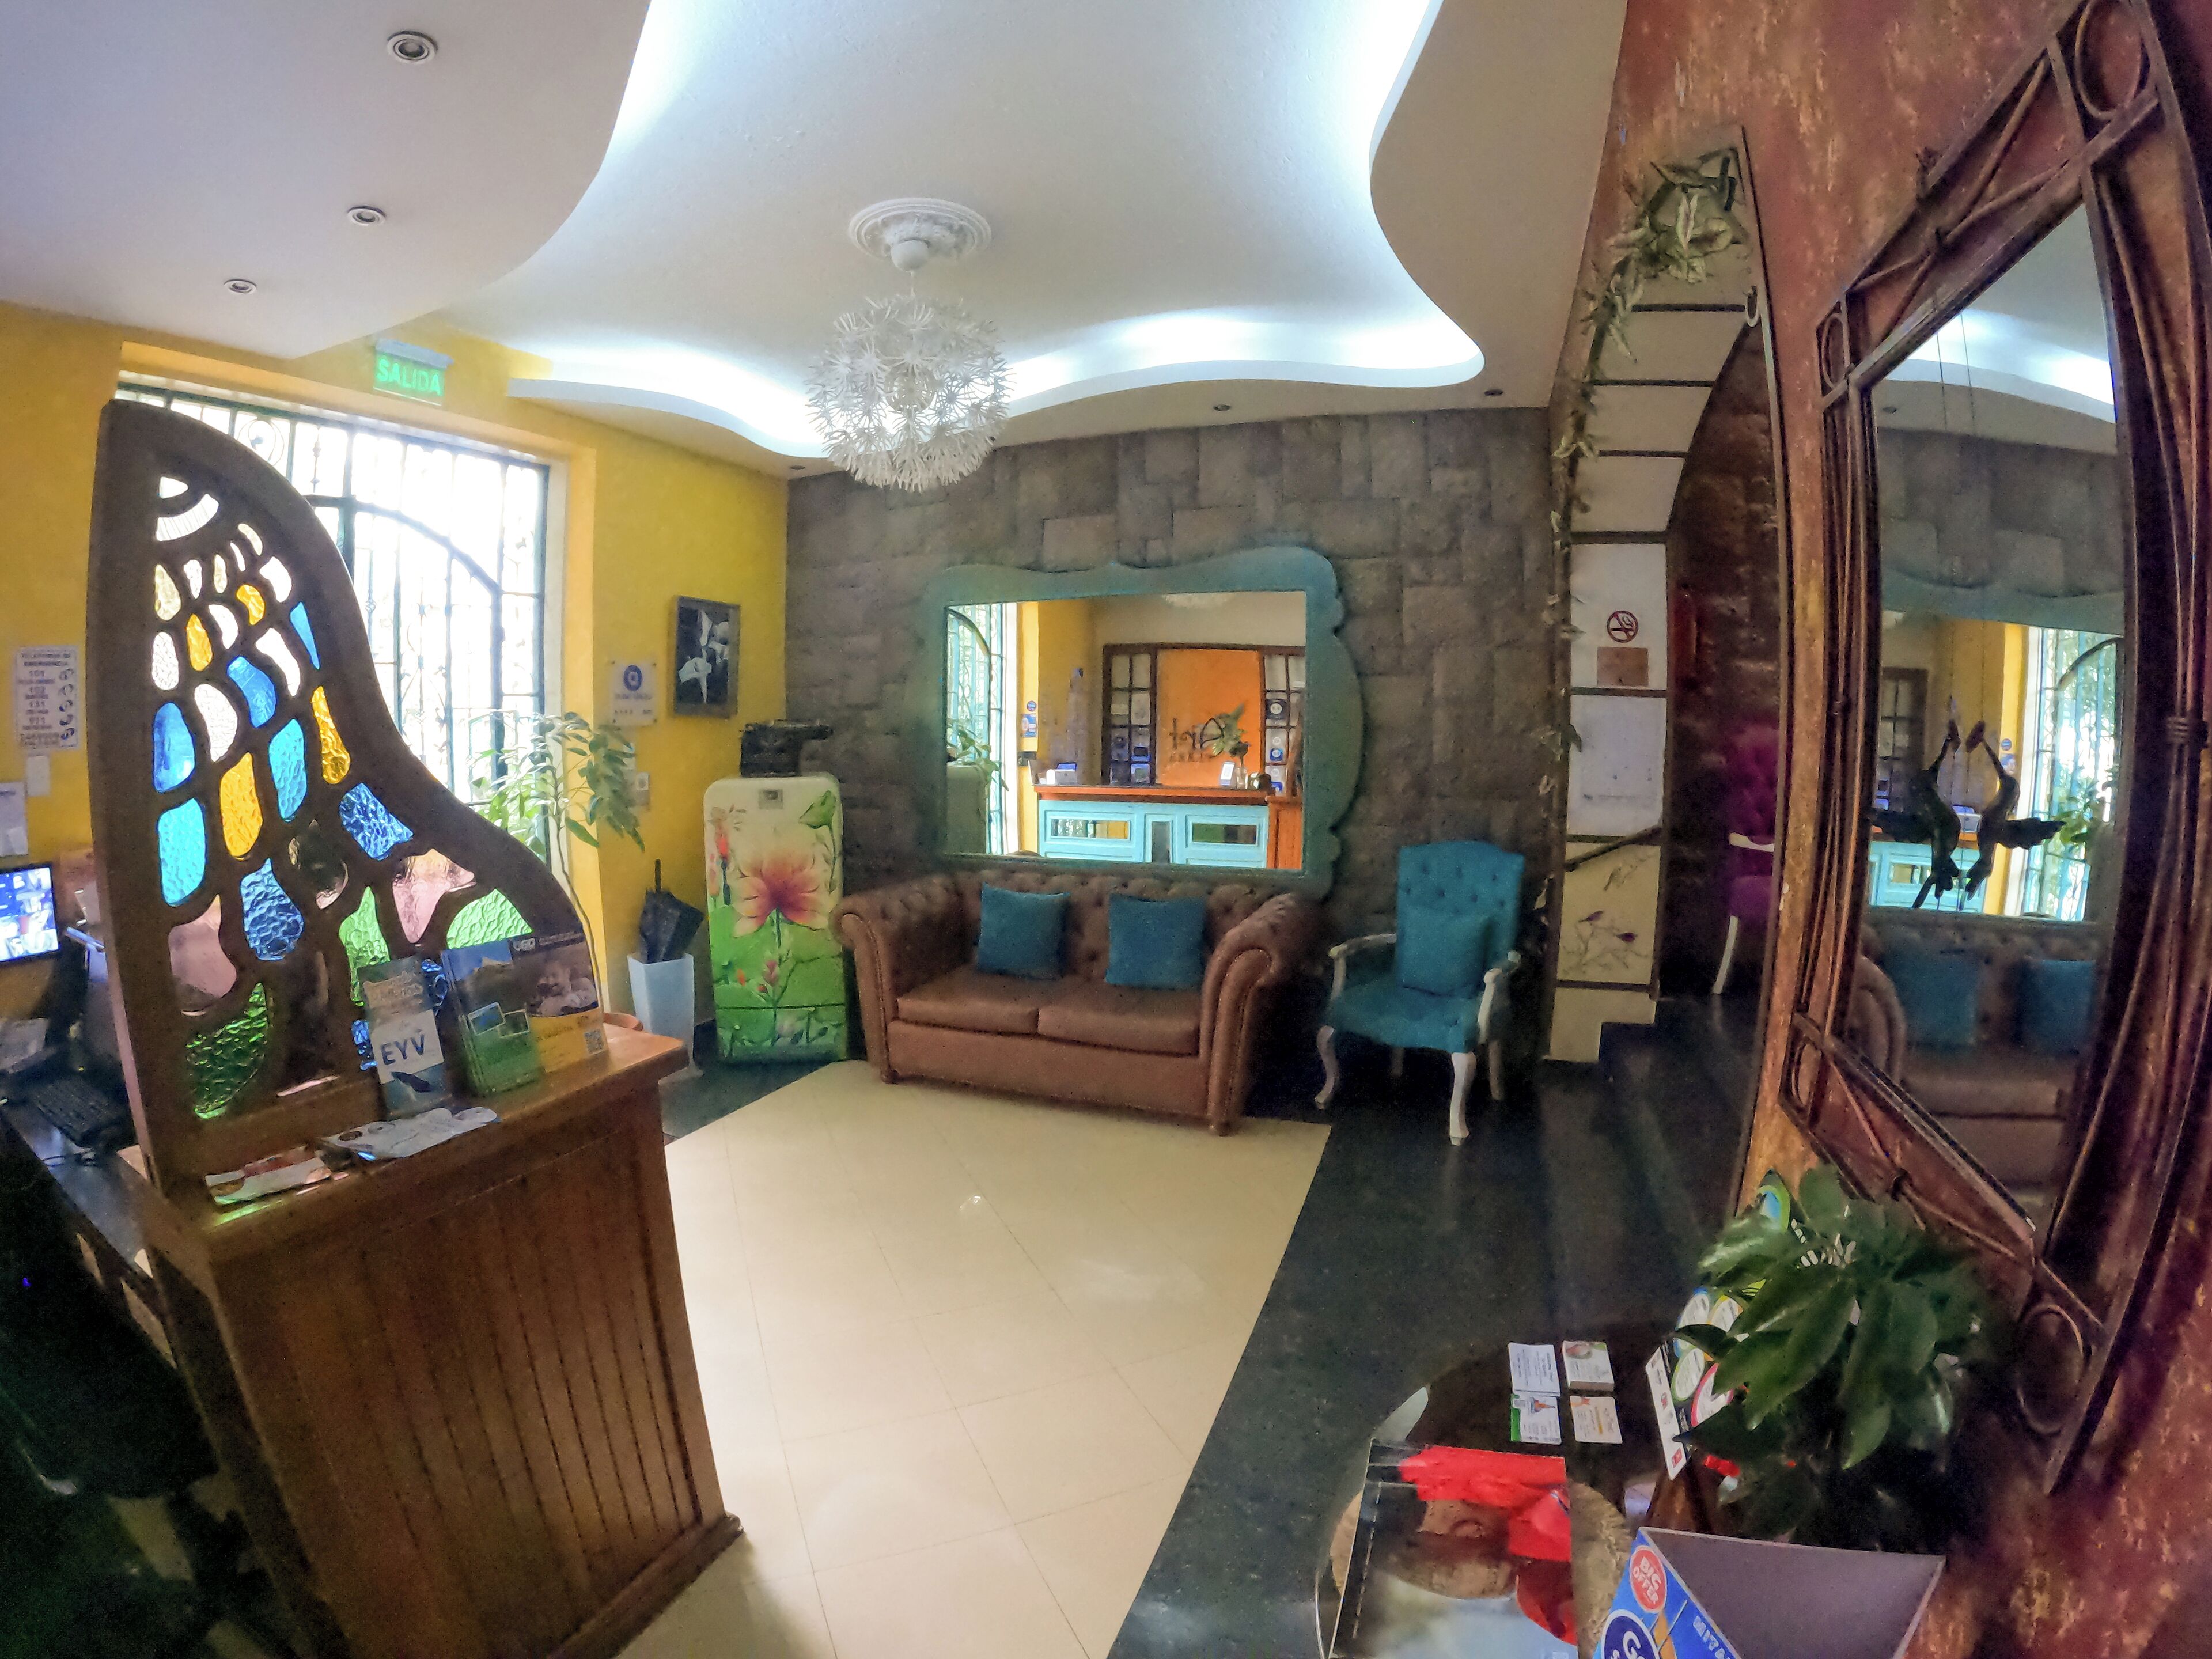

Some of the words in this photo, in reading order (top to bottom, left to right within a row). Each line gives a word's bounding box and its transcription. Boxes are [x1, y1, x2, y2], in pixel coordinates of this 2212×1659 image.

[377, 358, 442, 396] SALIDA
[381, 1034, 425, 1065] EYV
[1633, 1566, 1659, 1605] OFFER
[1639, 1556, 1661, 1590] BIG
